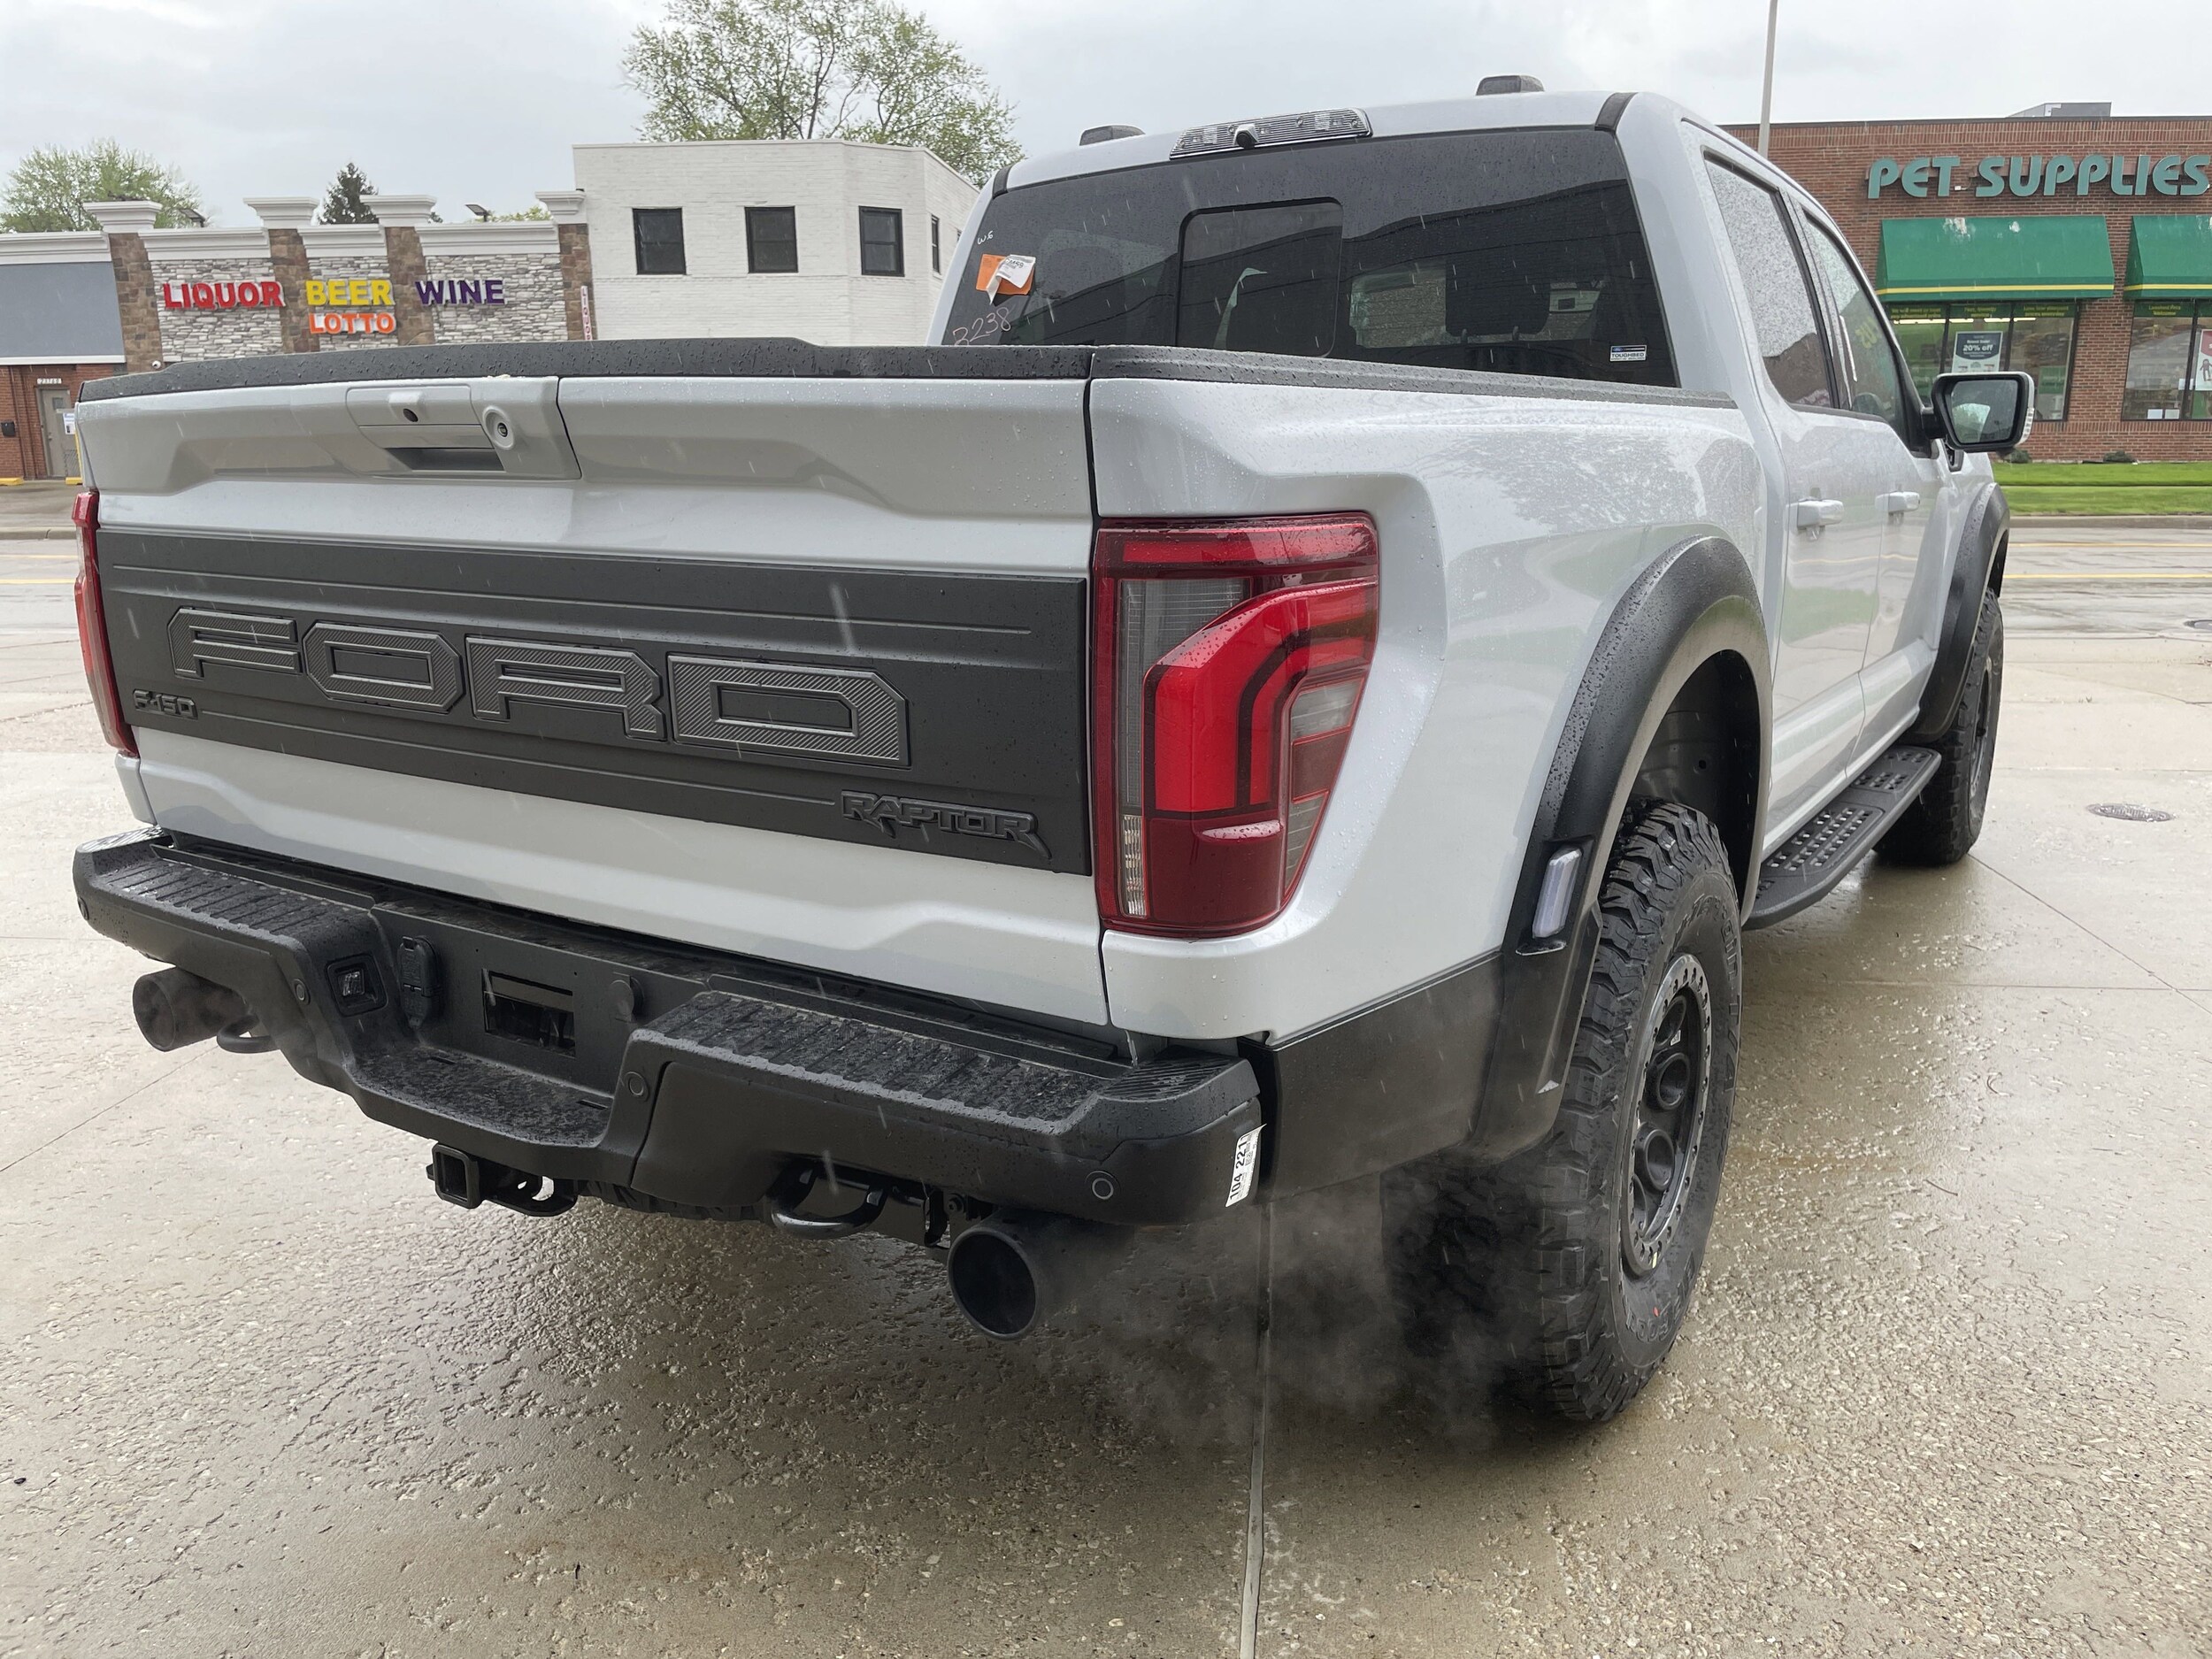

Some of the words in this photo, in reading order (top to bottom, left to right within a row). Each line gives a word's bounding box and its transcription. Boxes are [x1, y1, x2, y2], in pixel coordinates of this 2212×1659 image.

[1868, 156, 1961, 199] PET
[1975, 154, 2211, 197] SUPPLIES
[163, 280, 285, 310] LIQUOR
[305, 279, 395, 306] BEER
[414, 279, 505, 305] WINE
[308, 312, 396, 334] LOTTO
[166, 605, 911, 769] FORD
[133, 688, 199, 721] F-150
[841, 789, 1053, 861] RAPTOR
[1229, 1173, 1243, 1200] 104
